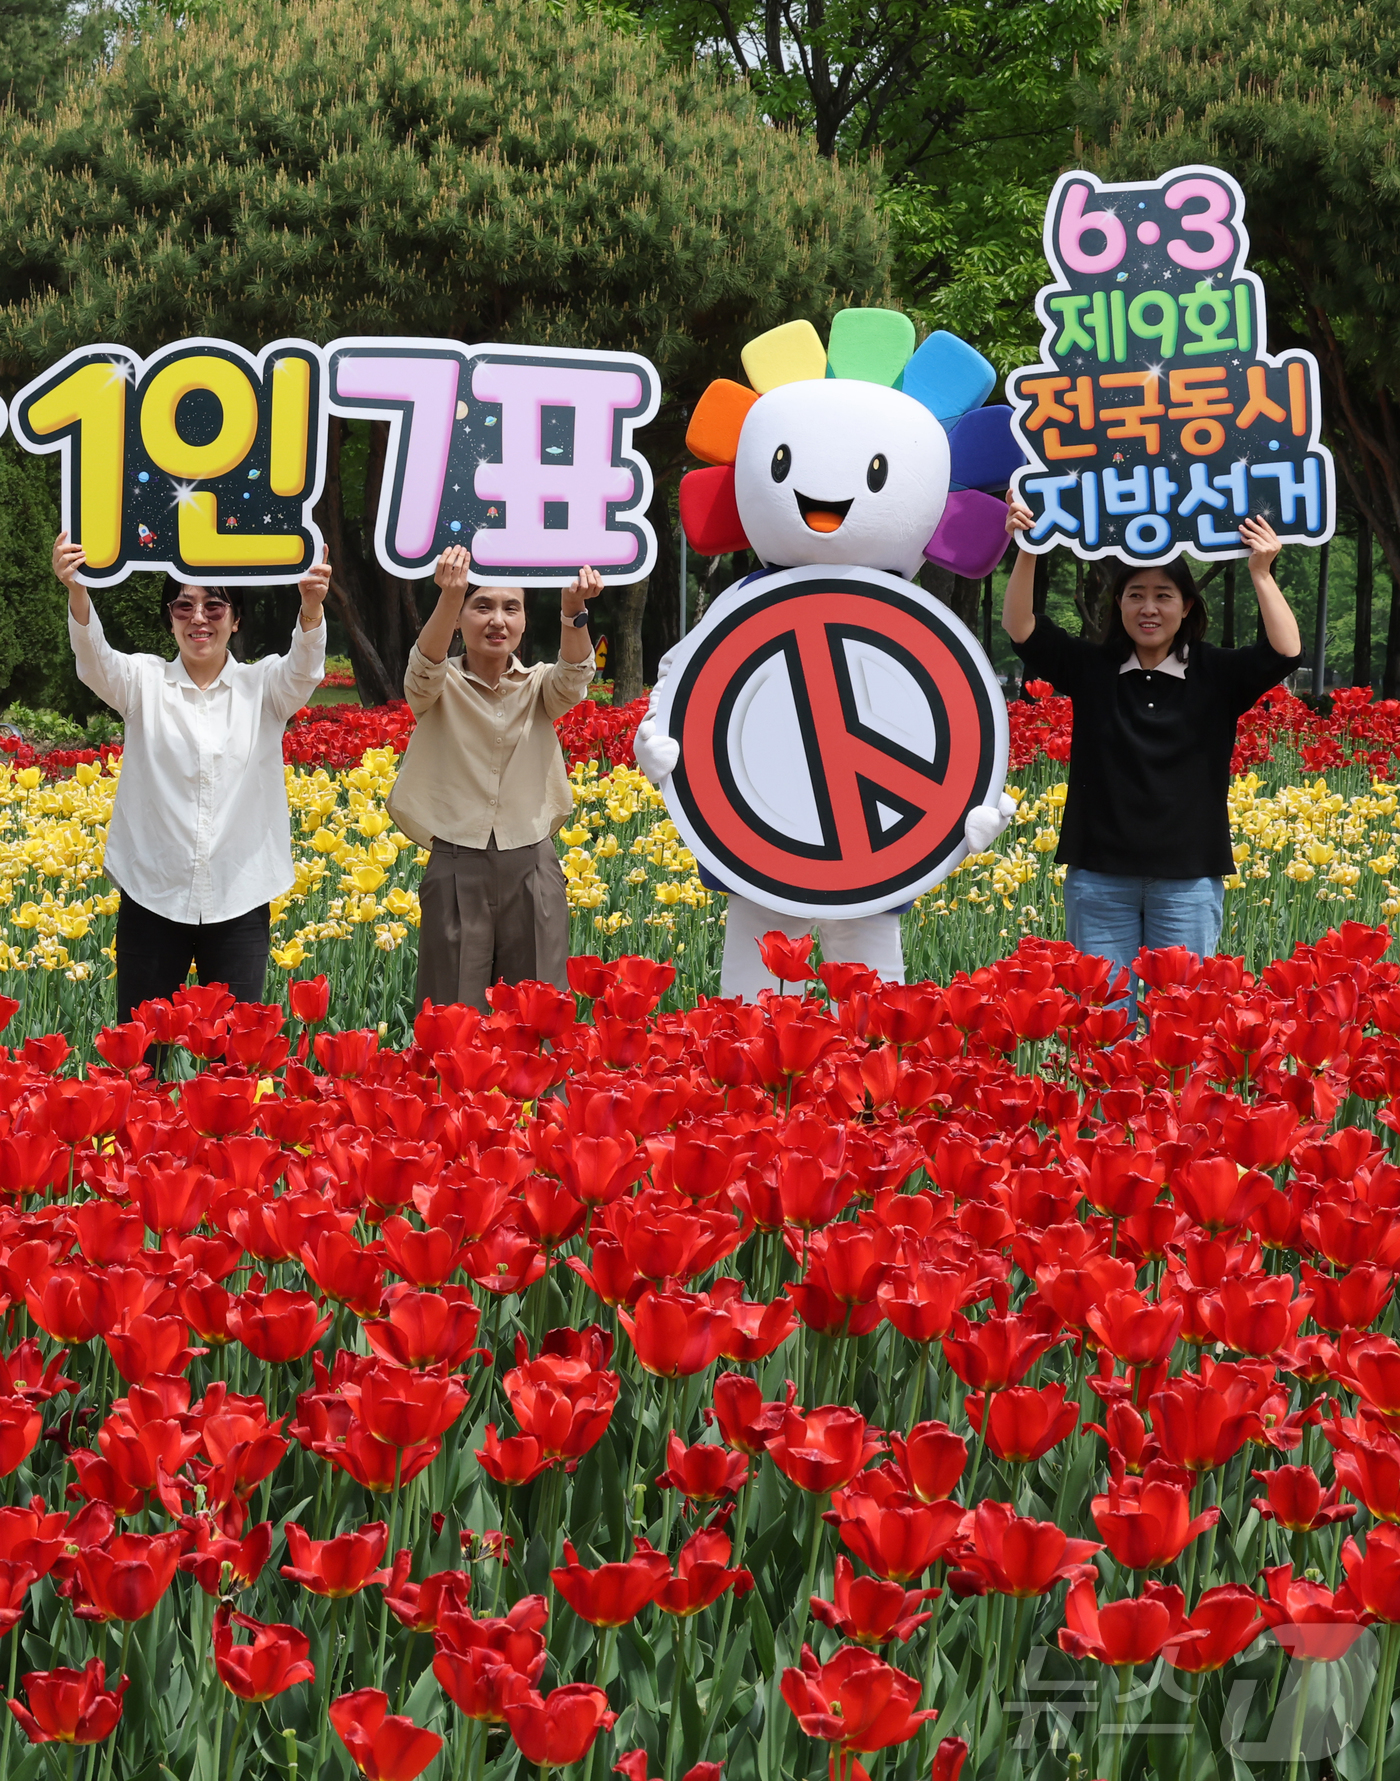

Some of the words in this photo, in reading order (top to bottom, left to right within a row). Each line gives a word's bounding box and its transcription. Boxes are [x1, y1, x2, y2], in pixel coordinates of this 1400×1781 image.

[1049, 280, 1252, 363] 제9회
[1020, 362, 1307, 461] 전국동시
[27, 355, 310, 569] 1인
[335, 356, 643, 567] 7표
[1024, 457, 1321, 554] 지방선거
